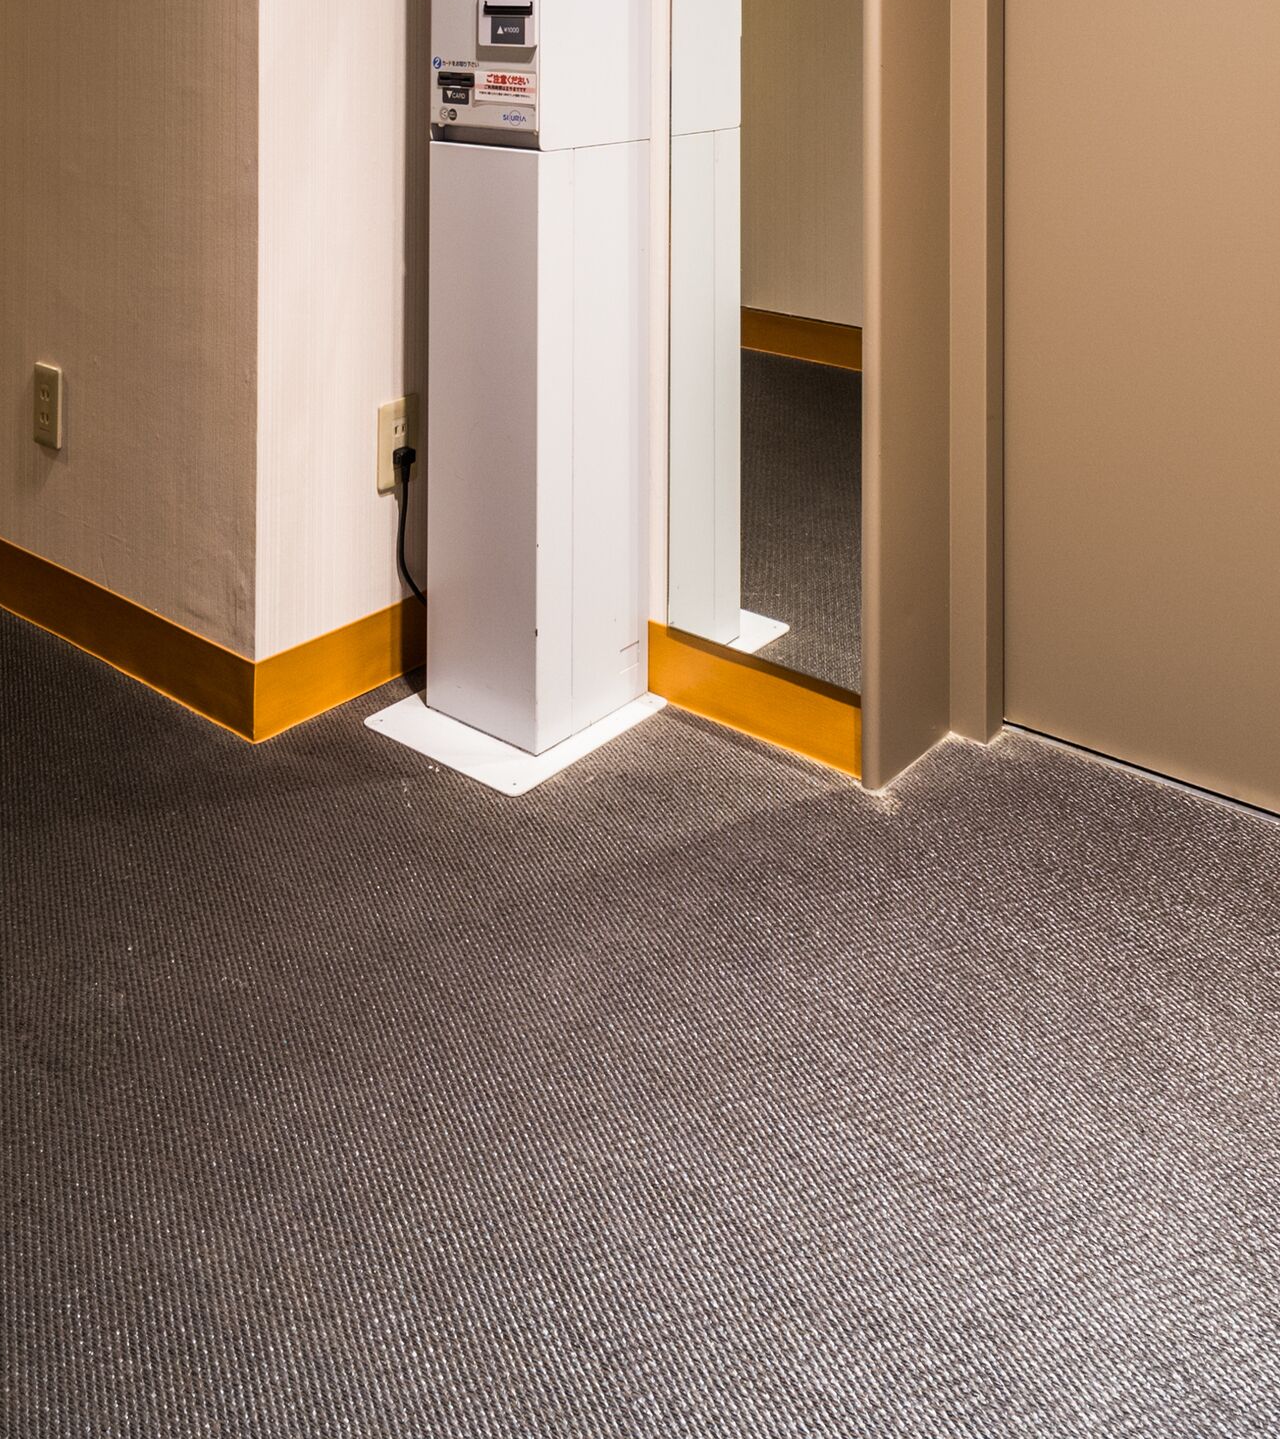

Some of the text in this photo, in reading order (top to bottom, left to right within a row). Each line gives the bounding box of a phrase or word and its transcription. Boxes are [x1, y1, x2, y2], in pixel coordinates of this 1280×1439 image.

[486, 74, 530, 86] ご注意ください
